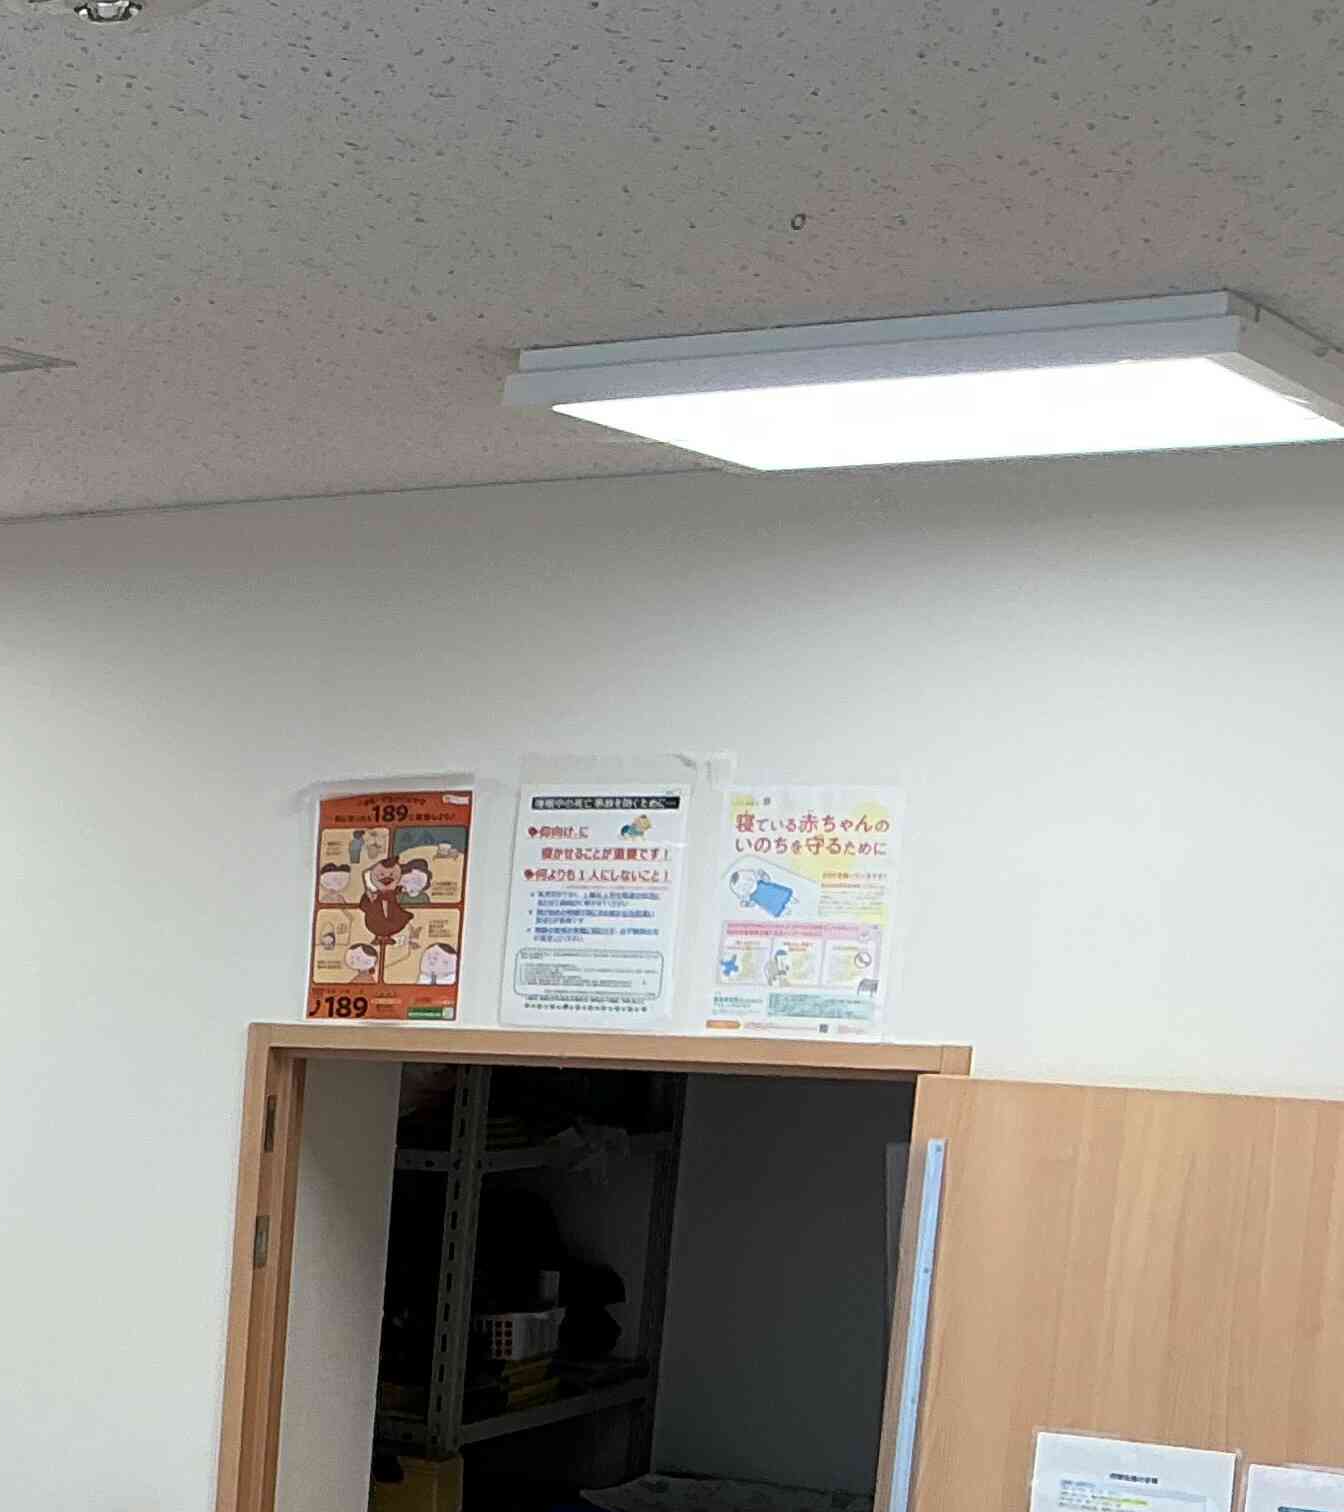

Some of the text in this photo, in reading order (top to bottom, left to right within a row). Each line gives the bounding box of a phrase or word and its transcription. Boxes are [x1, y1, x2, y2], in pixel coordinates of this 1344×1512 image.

[372, 805, 409, 823] 189
[735, 812, 890, 832] 寝ている赤ちゃんの
[735, 836, 887, 855] いのちを守るために
[324, 997, 368, 1018] 189
